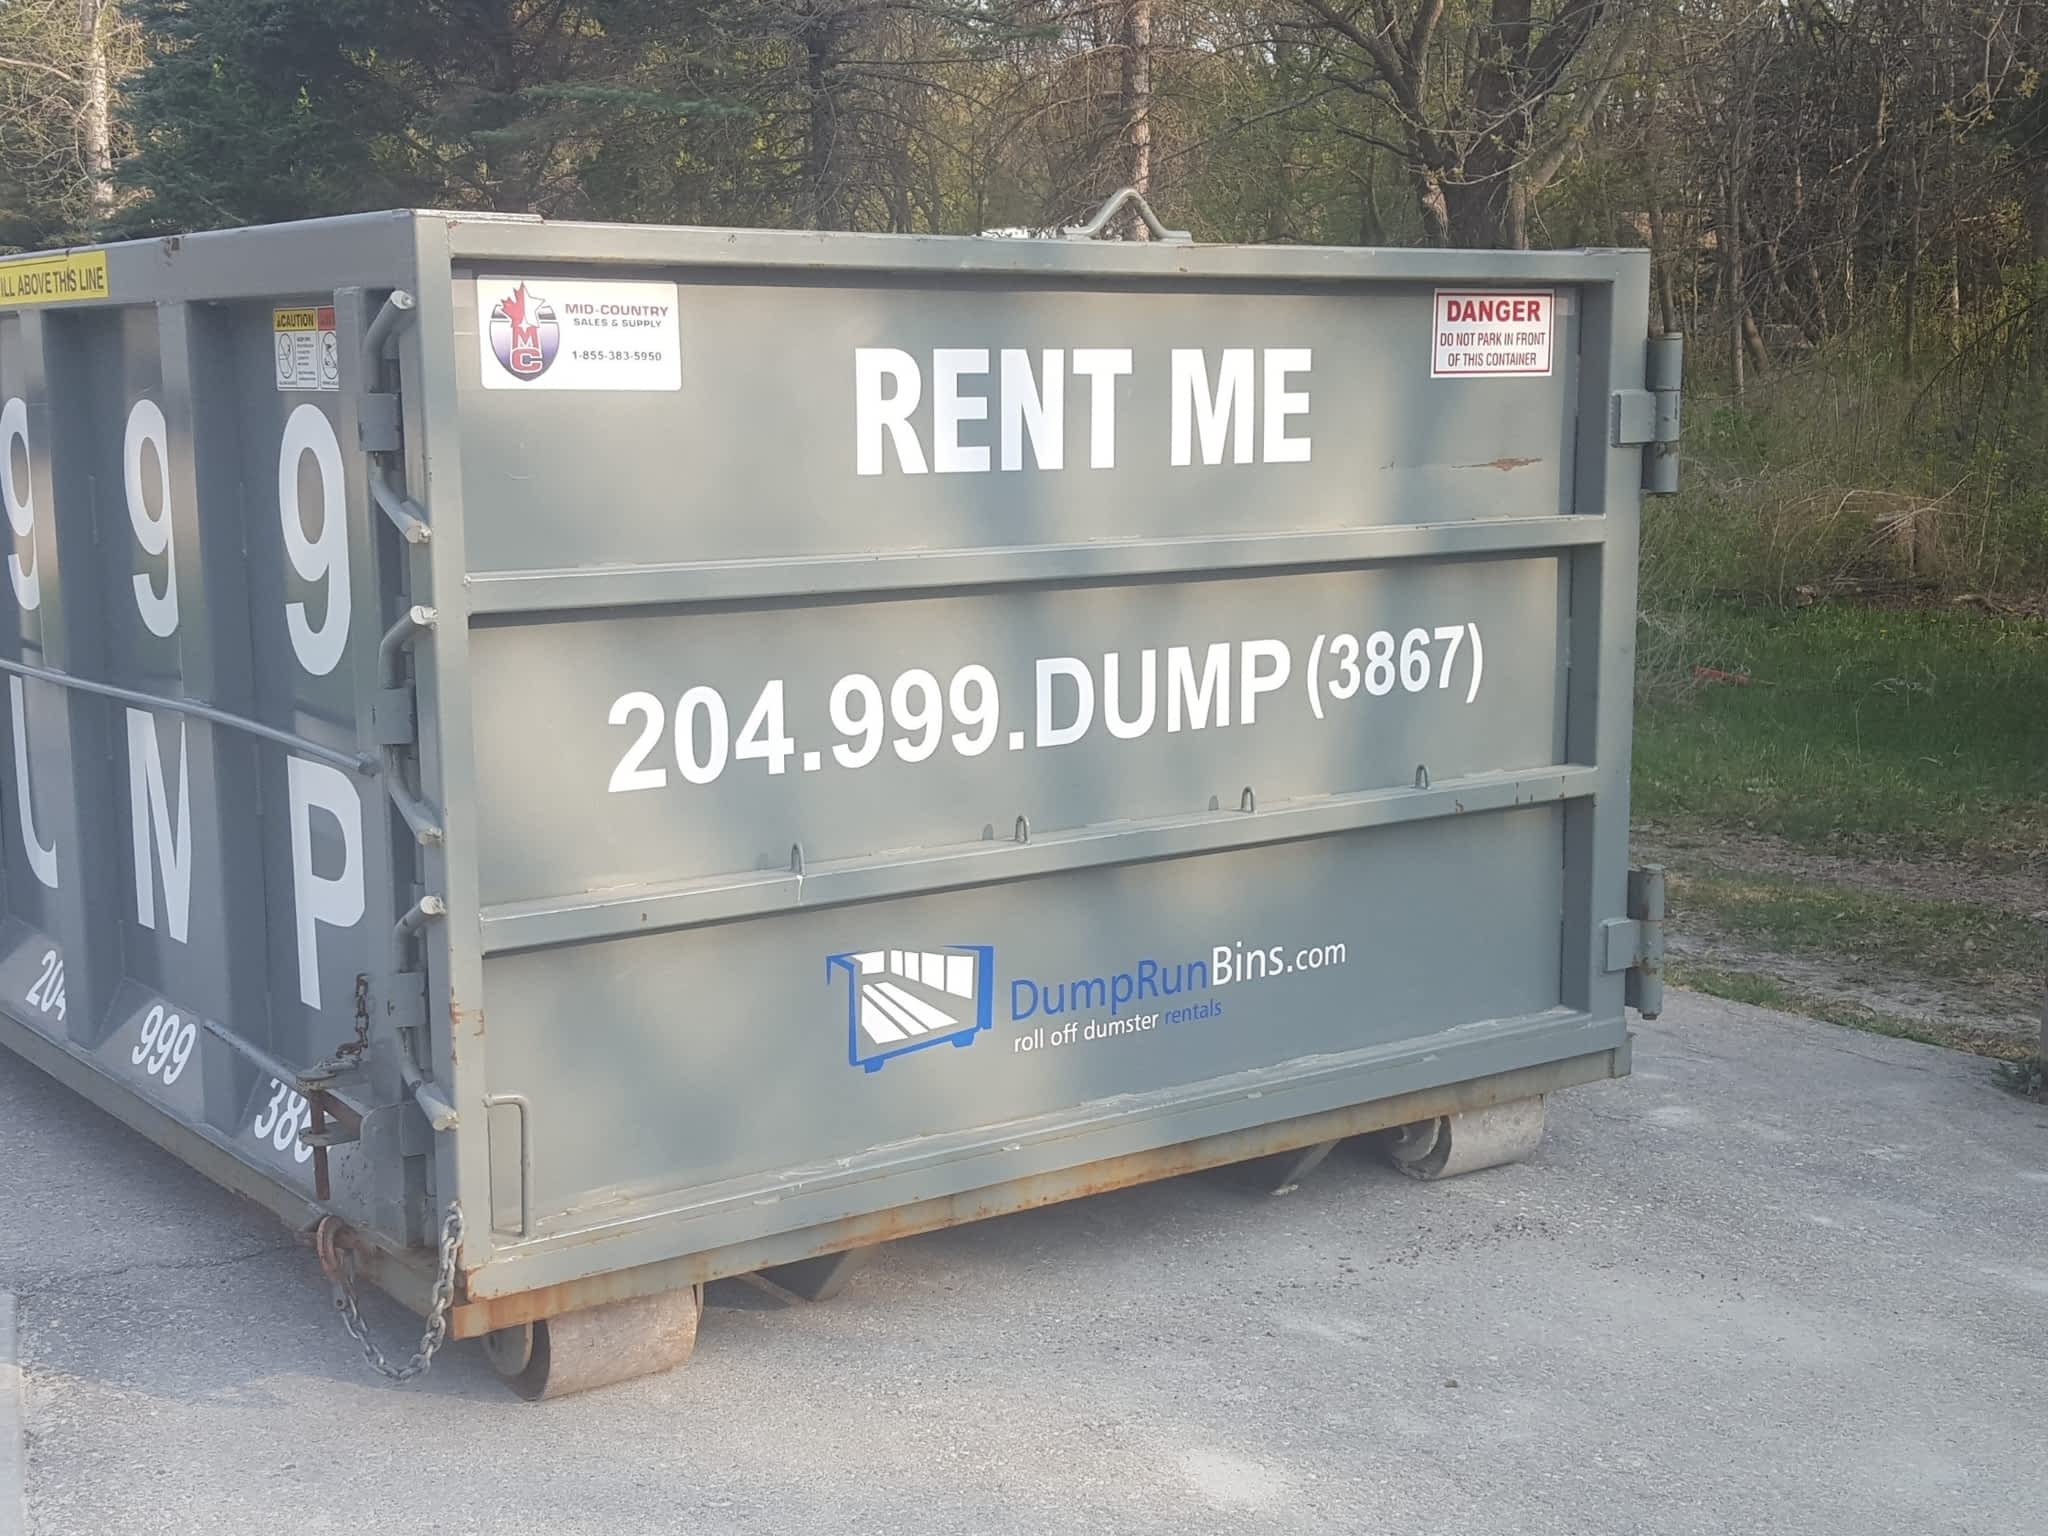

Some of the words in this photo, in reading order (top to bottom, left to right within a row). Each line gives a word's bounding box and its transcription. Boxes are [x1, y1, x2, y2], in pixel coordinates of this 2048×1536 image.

[18, 272, 52, 297] ABOVE
[53, 268, 77, 293] THIS
[80, 266, 104, 291] LINE
[280, 312, 314, 329] CAUTION
[565, 303, 669, 317] MID-COUNTRY
[1447, 300, 1541, 322] DANGER
[573, 318, 608, 327] SALES
[611, 319, 618, 327] &
[622, 319, 662, 328] SUPPLY
[1440, 332, 1454, 346] DO
[1456, 332, 1475, 346] NOT
[1477, 332, 1502, 346] PARK
[1504, 332, 1514, 346] IN
[1516, 332, 1546, 346] FRONT
[572, 350, 662, 361] 1-855-383-5950
[1447, 353, 1461, 367] OF
[1463, 353, 1483, 367] THIS
[1486, 352, 1537, 366] CONTAINER
[855, 347, 1133, 476] RENT
[1170, 348, 1312, 466] ME
[1304, 622, 1484, 720] (3867)
[1010, 941, 1346, 1022] DumpRunBins.com
[1014, 1028, 1044, 1052] roll
[1050, 1022, 1079, 1047] off
[1084, 1012, 1160, 1041] dumster
[1164, 998, 1222, 1025] rentals
[132, 1005, 196, 1086] 999
